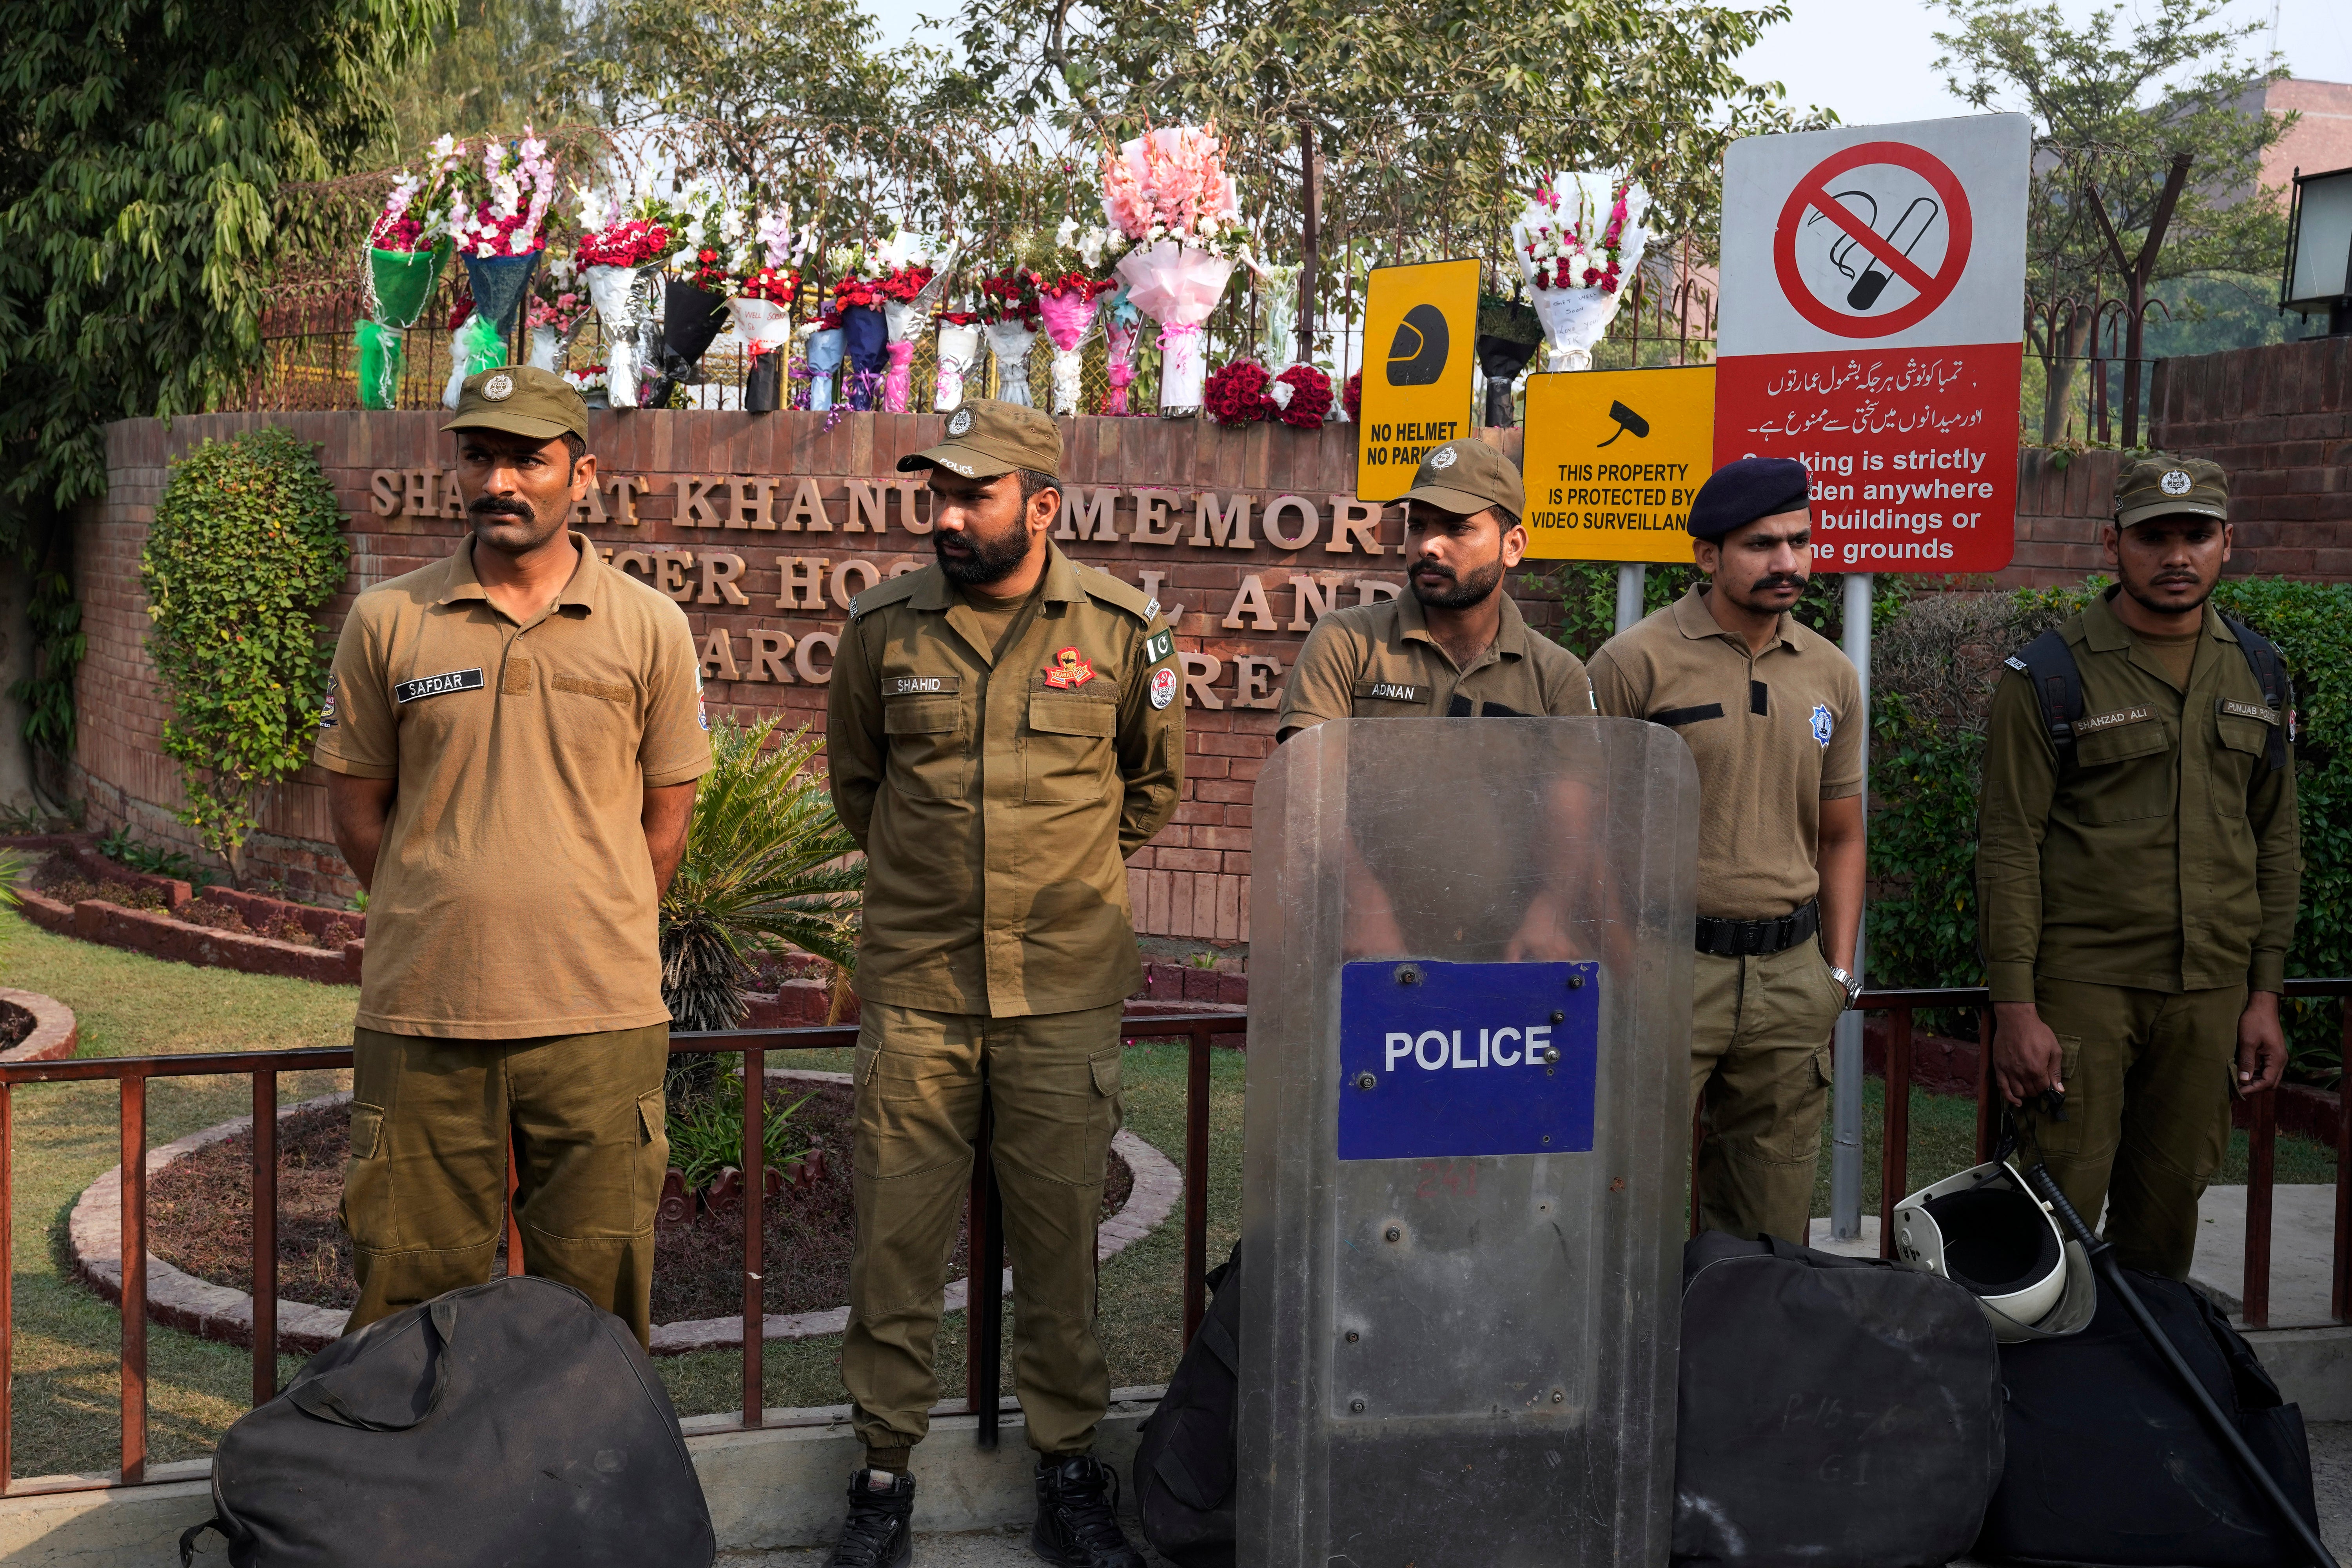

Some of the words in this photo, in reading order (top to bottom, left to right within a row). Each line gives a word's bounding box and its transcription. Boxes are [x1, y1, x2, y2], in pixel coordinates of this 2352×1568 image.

[1578, 292, 1597, 301] WELL
[767, 312, 786, 321] SOON
[1822, 419, 1850, 431] سے
[1852, 399, 1880, 434] سختی
[1870, 408, 1897, 433] میں
[1371, 424, 1391, 442] NO
[1396, 422, 1457, 441] HELMET
[1367, 447, 1387, 465] NO
[1392, 446, 1436, 465] PARK
[1863, 450, 1884, 470] is
[1893, 448, 1986, 474] strictly
[939, 458, 975, 475] POLICE
[1558, 464, 1592, 481] THIS
[1598, 464, 1689, 481] PROPERTY
[1549, 488, 1563, 505] IS
[1568, 489, 1666, 506] PROTECTED
[1672, 489, 1695, 506] BY
[1863, 479, 1993, 505] anywhere
[671, 475, 934, 535] KHANU
[1532, 512, 1579, 528] VIDEO
[1583, 513, 1687, 530] SURVEILLAN
[1821, 509, 1943, 534] buildings
[1952, 512, 1982, 528] or
[1843, 538, 1954, 564] grounds
[409, 674, 462, 697] SAFDAR
[898, 678, 940, 692] SHAHID
[1372, 683, 1415, 700] ADNAN
[2228, 702, 2257, 715] PUNJAB
[2078, 713, 2125, 731] SHAHZAD
[2131, 708, 2147, 720] ALI
[1385, 1025, 1552, 1072] POLICE
[1416, 1160, 1477, 1199] 241
